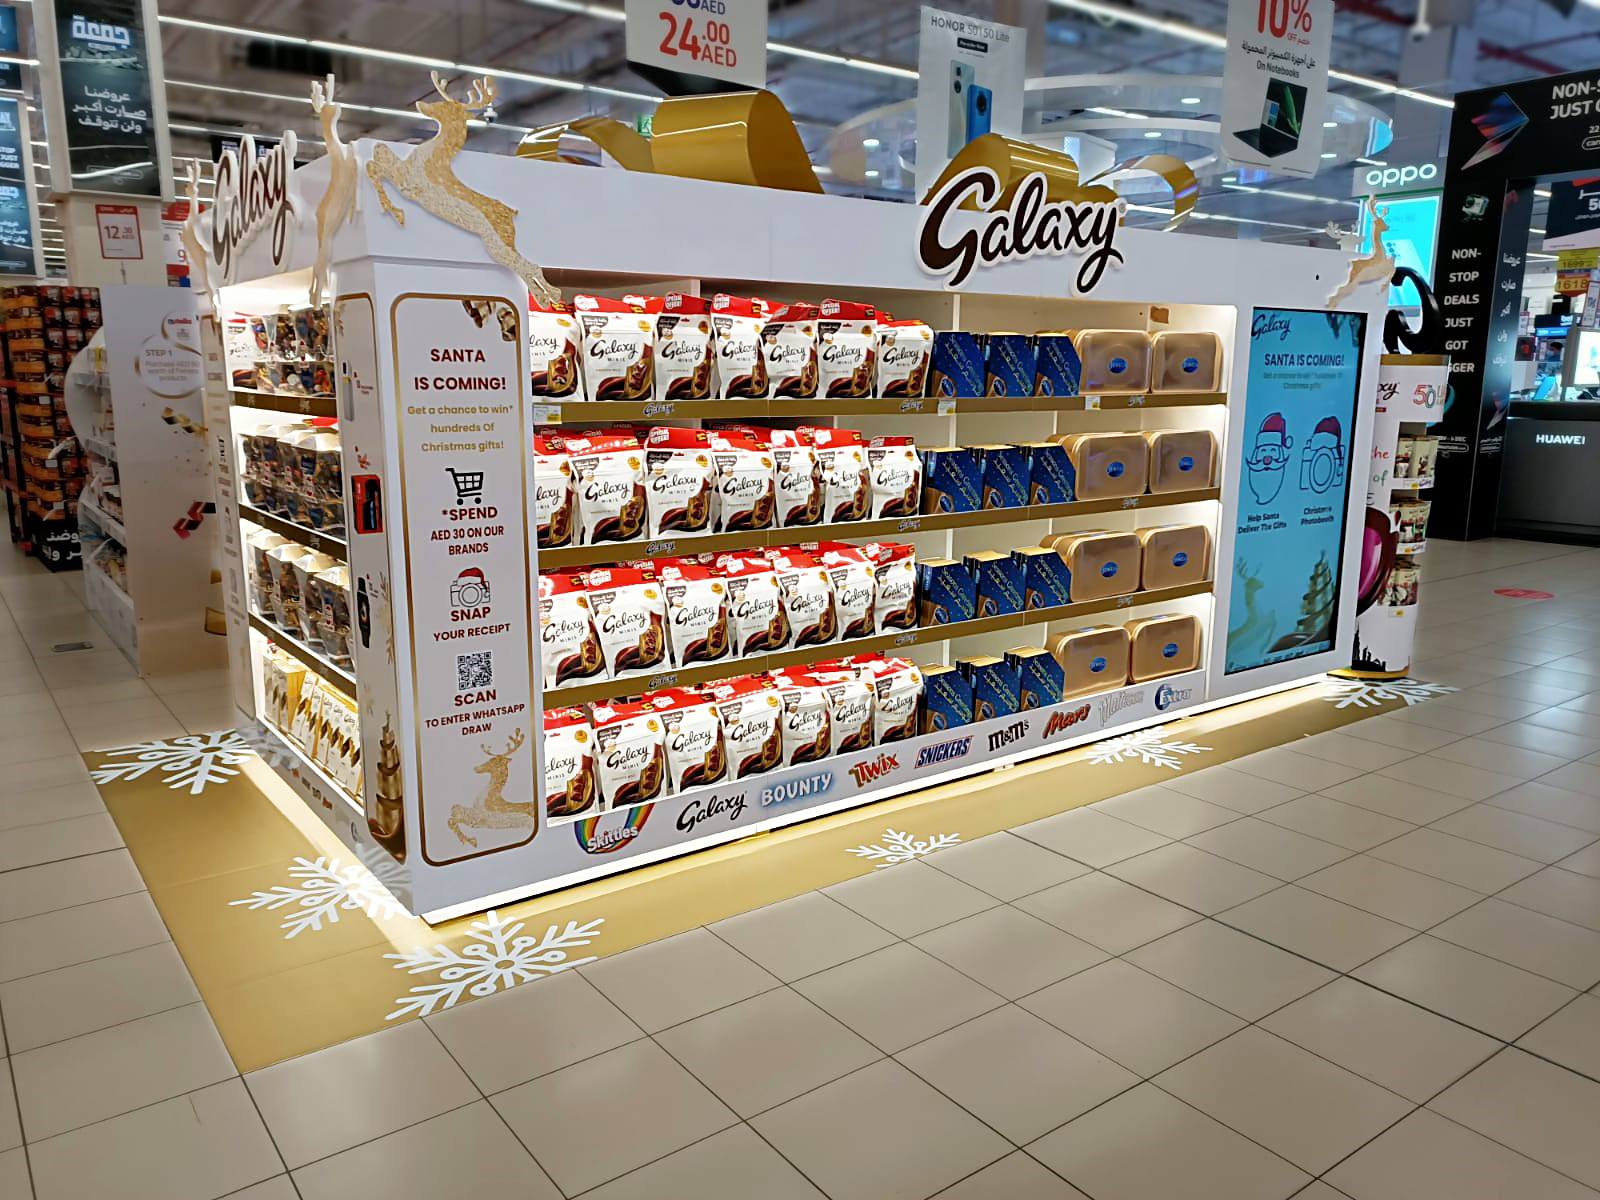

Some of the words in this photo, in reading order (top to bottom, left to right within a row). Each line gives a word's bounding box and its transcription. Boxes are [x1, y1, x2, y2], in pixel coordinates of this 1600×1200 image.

[700, 0, 726, 14] AED
[72, 14, 131, 50] جمعة
[931, 16, 965, 33] HONOR
[984, 28, 994, 40] 50
[996, 31, 1010, 42] Lite
[701, 44, 737, 67] AED
[1256, 60, 1266, 70] On
[1266, 62, 1300, 78] Notebooks
[1550, 100, 1594, 120] JUST
[120, 120, 142, 134] ولن
[1365, 163, 1437, 188] oppo
[212, 138, 296, 280] Galaxy
[918, 170, 1124, 294] Galaxy
[1452, 248, 1482, 260] NON-
[1450, 271, 1480, 282] STOP
[1444, 294, 1480, 306] DEALS
[1251, 314, 1292, 340] Galaxy
[1445, 317, 1474, 328] JUST
[430, 348, 486, 362] SANTA
[530, 336, 561, 354] laxy
[590, 340, 638, 360] Galaxy
[662, 340, 703, 361] Galaxy
[722, 340, 756, 360] Galaxy
[770, 344, 808, 363] Galaxy
[822, 344, 862, 364] Galaxy
[1446, 340, 1468, 351] GOT
[882, 348, 921, 365] Galaxy
[1264, 353, 1295, 366] SANTA
[1296, 354, 1305, 366] IS
[1306, 354, 1344, 366] COMING!
[414, 376, 428, 390] IS
[433, 376, 506, 390] COMING!
[407, 405, 427, 415] Get
[438, 405, 477, 415] chance
[479, 405, 490, 414] to
[430, 424, 481, 434] hundreds
[483, 422, 494, 432] Of
[421, 442, 476, 452] Christmas
[478, 440, 504, 452] gifts!
[1536, 433, 1586, 446] HUAWEI
[652, 474, 698, 493] Galaxy
[722, 477, 764, 494] Galaxy
[876, 470, 912, 486] Galaxy
[536, 486, 562, 506] laxy
[585, 482, 630, 502] Galaxy
[430, 529, 450, 542] AED
[452, 528, 465, 540] 30
[467, 526, 482, 538] ON
[484, 526, 504, 537] OUR
[1238, 525, 1260, 534] Deliver
[448, 542, 489, 556] BRANDS
[841, 588, 872, 607] Galaxy
[450, 606, 491, 622] SNAP
[675, 606, 718, 626] Galaxy
[736, 598, 778, 620] Galaxy
[542, 620, 586, 643] Galaxy
[602, 610, 648, 634] Galaxy
[433, 628, 465, 642] YOUR
[467, 623, 511, 638] RECEIPT
[454, 689, 498, 706] SCAN
[1159, 686, 1192, 706] Extra
[425, 718, 439, 730] TO
[440, 713, 471, 726] ENTER
[472, 704, 526, 722] WHATSAPP
[788, 710, 824, 732] Galaxy
[836, 702, 870, 722] Galaxy
[1042, 704, 1092, 738] Mars
[461, 723, 492, 736] DRAW
[731, 718, 772, 742] Galaxy
[672, 730, 714, 752] Galaxy
[606, 746, 650, 770] Galaxy
[918, 738, 970, 766] SNICKERS
[545, 756, 578, 774] alaxy
[849, 752, 900, 786] Twix
[761, 772, 833, 808] BOUNTY
[676, 791, 748, 833] Galaxy
[586, 824, 638, 852] Skittles
